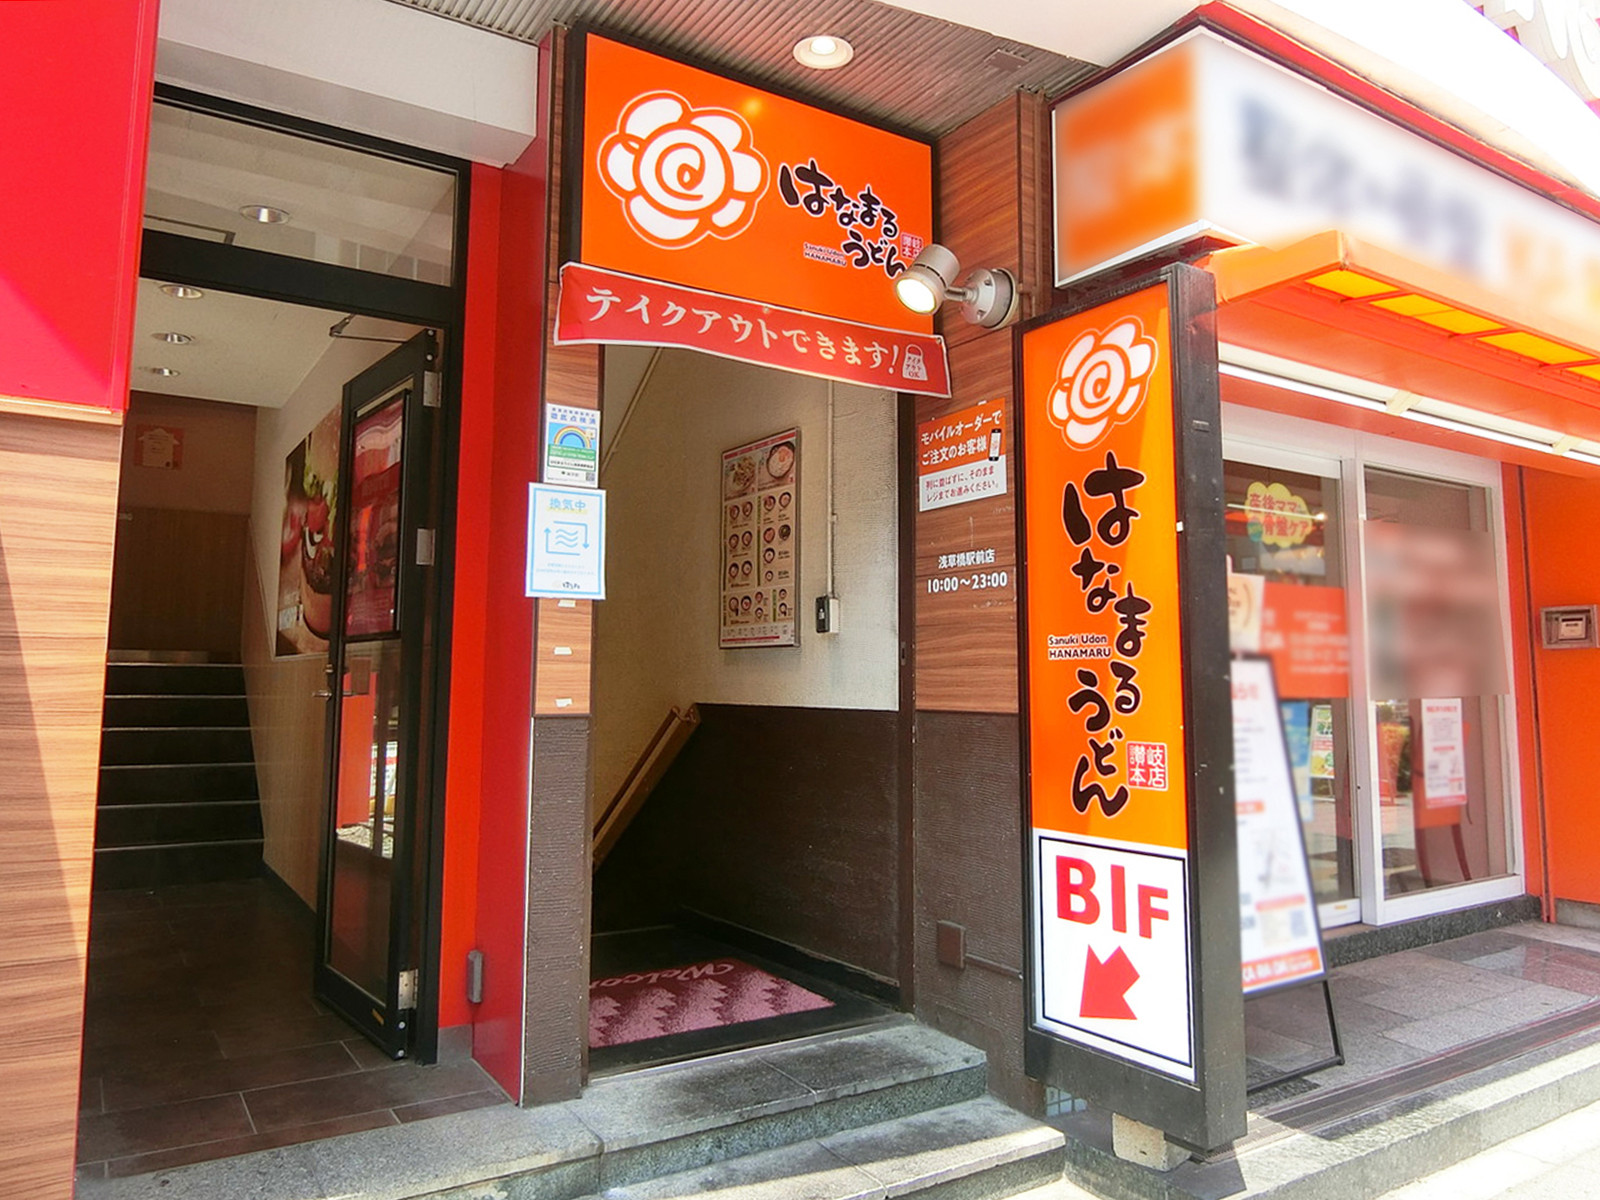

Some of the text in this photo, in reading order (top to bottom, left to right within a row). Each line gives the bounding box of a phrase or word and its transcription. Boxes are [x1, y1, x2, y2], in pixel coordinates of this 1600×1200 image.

[778, 158, 898, 239] はなまる
[842, 229, 907, 278] うどん
[921, 410, 1003, 445] モバイルオーダーで
[922, 436, 987, 466] ご注文のお客様
[938, 549, 996, 569] 浅草橋駅前店
[1048, 634, 1107, 646] Sanuki Udon
[1049, 647, 1111, 659] HANAMARU
